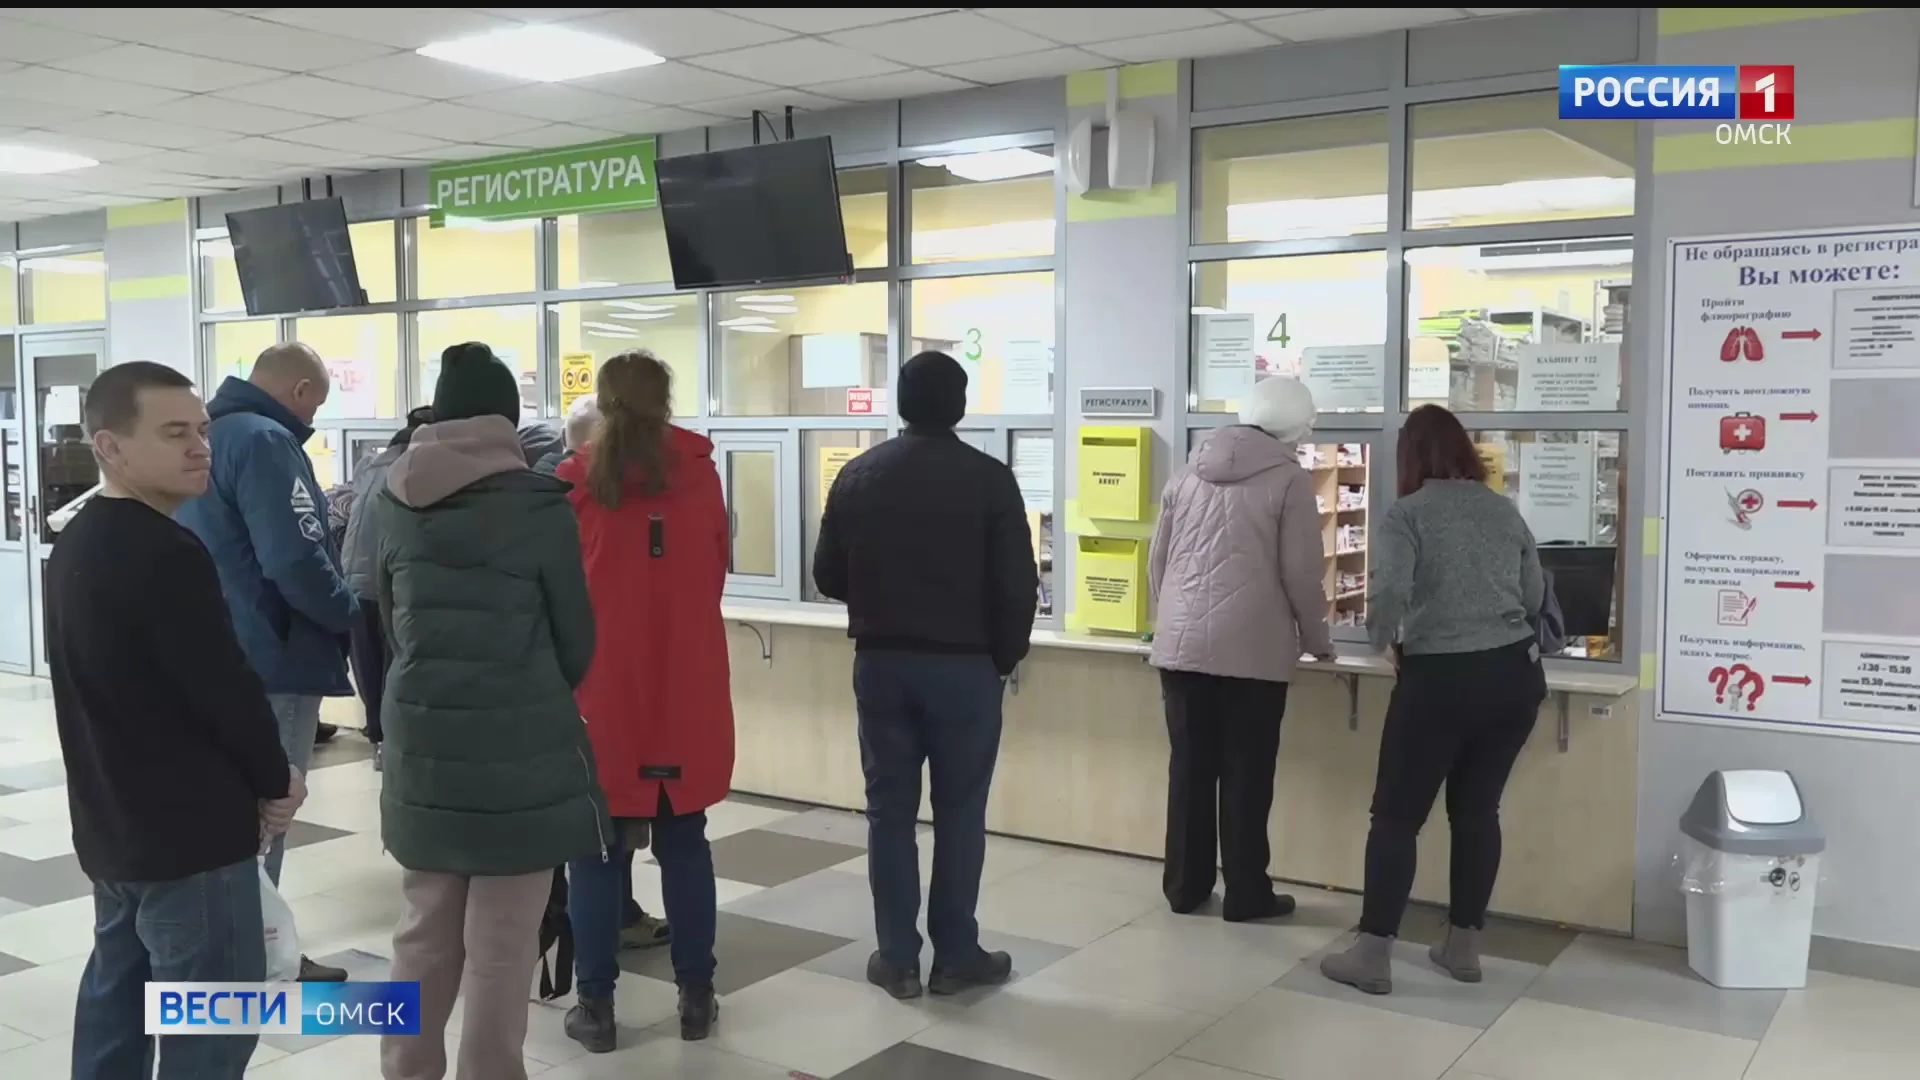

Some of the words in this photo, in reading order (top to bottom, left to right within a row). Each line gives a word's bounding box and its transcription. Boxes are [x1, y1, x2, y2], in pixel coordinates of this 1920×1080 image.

[437, 154, 647, 209] РЕГИСТРАТУРА
[1685, 247, 1708, 261] Не
[1713, 245, 1811, 262] обращаясь
[1817, 244, 1827, 254] в
[1738, 266, 1779, 286] Вы
[1789, 264, 1900, 283] можете:
[1701, 298, 1745, 309] Пройти
[1700, 309, 1791, 323] флюорографию
[1266, 312, 1291, 348] 4
[965, 328, 982, 361] 3
[1085, 398, 1148, 407] РЕГИСТРАТУРА
